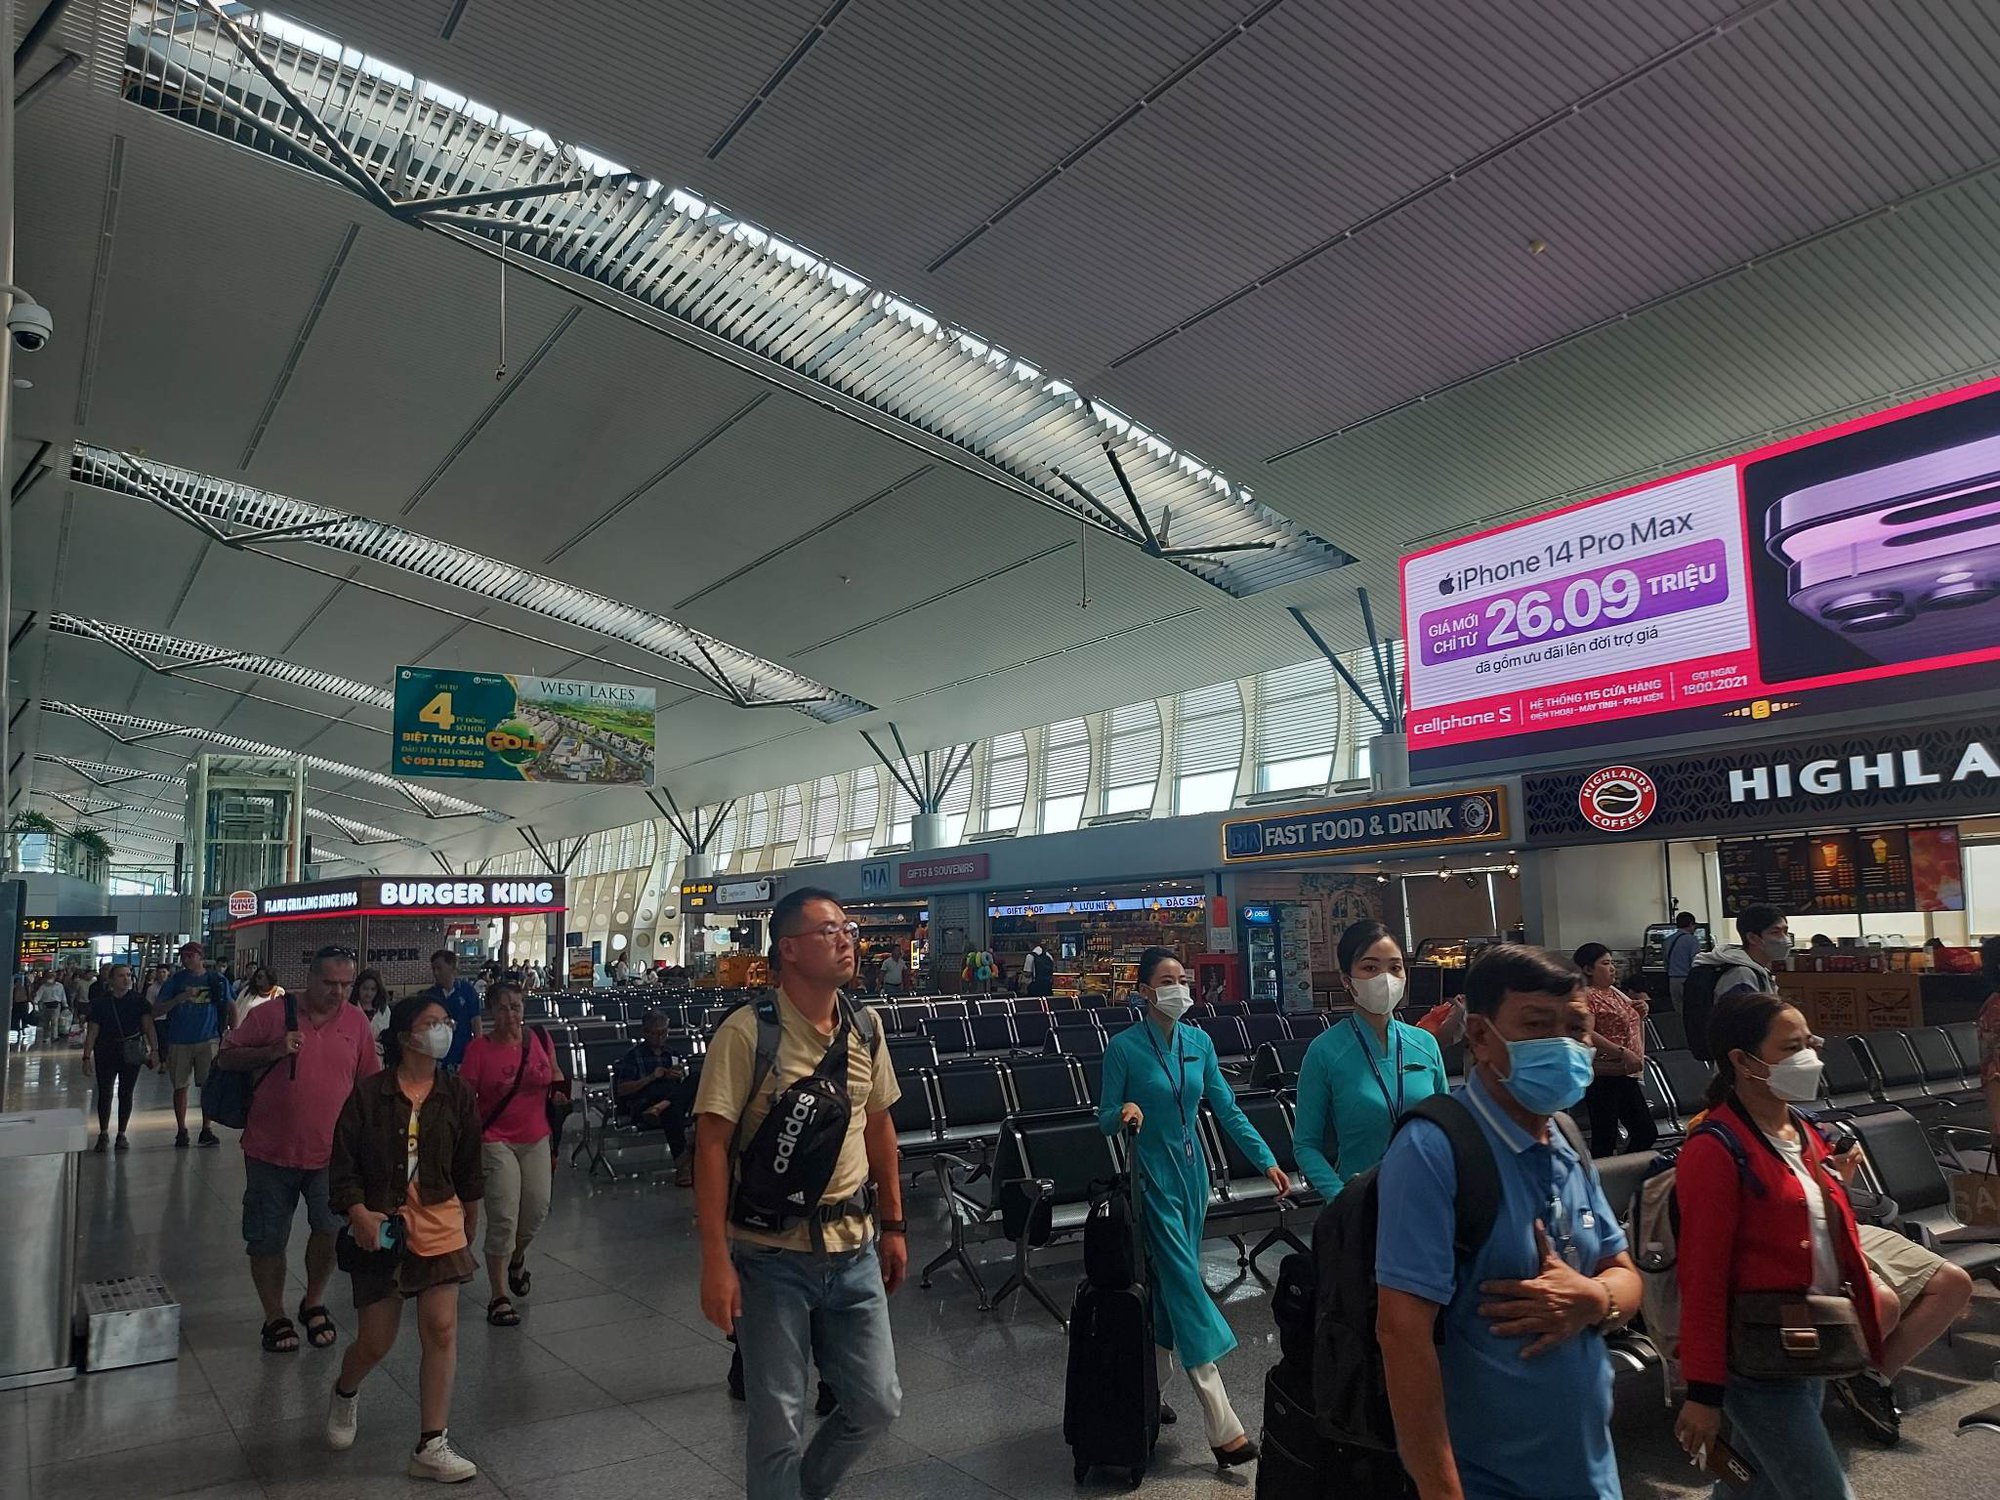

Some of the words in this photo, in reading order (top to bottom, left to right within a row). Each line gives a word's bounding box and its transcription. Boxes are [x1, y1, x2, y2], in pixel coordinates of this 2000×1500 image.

[1457, 551, 1541, 593] iPhone
[1545, 540, 1573, 568] 14
[1578, 532, 1624, 560] Pro
[1631, 512, 1694, 547] Max
[1646, 563, 1717, 597] TRIỆU
[1485, 568, 1641, 647] 26.09
[1428, 620, 1451, 638] GIÁ
[1452, 613, 1479, 633] MỚI
[1457, 631, 1479, 650] TỪ
[1475, 658, 1491, 674] đã
[1493, 653, 1521, 674] gồm
[1523, 650, 1541, 666] ưu
[1544, 645, 1564, 660] đãi
[1566, 640, 1586, 657] lên
[1588, 635, 1612, 653] đời
[1613, 634, 1635, 651] trợ
[1636, 625, 1659, 645] giá
[1711, 666, 1738, 678] NGAY
[541, 682, 585, 697] WEST
[590, 685, 635, 701] LAKES
[1583, 690, 1600, 702] 115
[1628, 678, 1662, 694] HÀNG
[1681, 676, 1748, 696] 1800.2021
[419, 692, 455, 730] 4
[1413, 710, 1496, 736] cellphone
[402, 731, 429, 743] BIỆT
[459, 734, 484, 745] SÂN
[1583, 770, 1652, 798] HIGHLANDS
[1265, 824, 1307, 847] FAST
[1312, 817, 1365, 842] FOOD
[1368, 814, 1385, 836] &
[1388, 807, 1453, 834] DRINK
[1592, 810, 1645, 827] COFFEE
[864, 867, 888, 891] DIA
[907, 867, 927, 879] GIFTS
[934, 862, 975, 877] SOUVENIRS
[264, 898, 287, 913] FLAME
[287, 895, 319, 911] GRILLING
[319, 893, 340, 909] SINCE
[381, 882, 485, 905] BURGER
[492, 882, 554, 904] KING
[1006, 907, 1023, 915] GIFT
[773, 1092, 815, 1174] adidas
